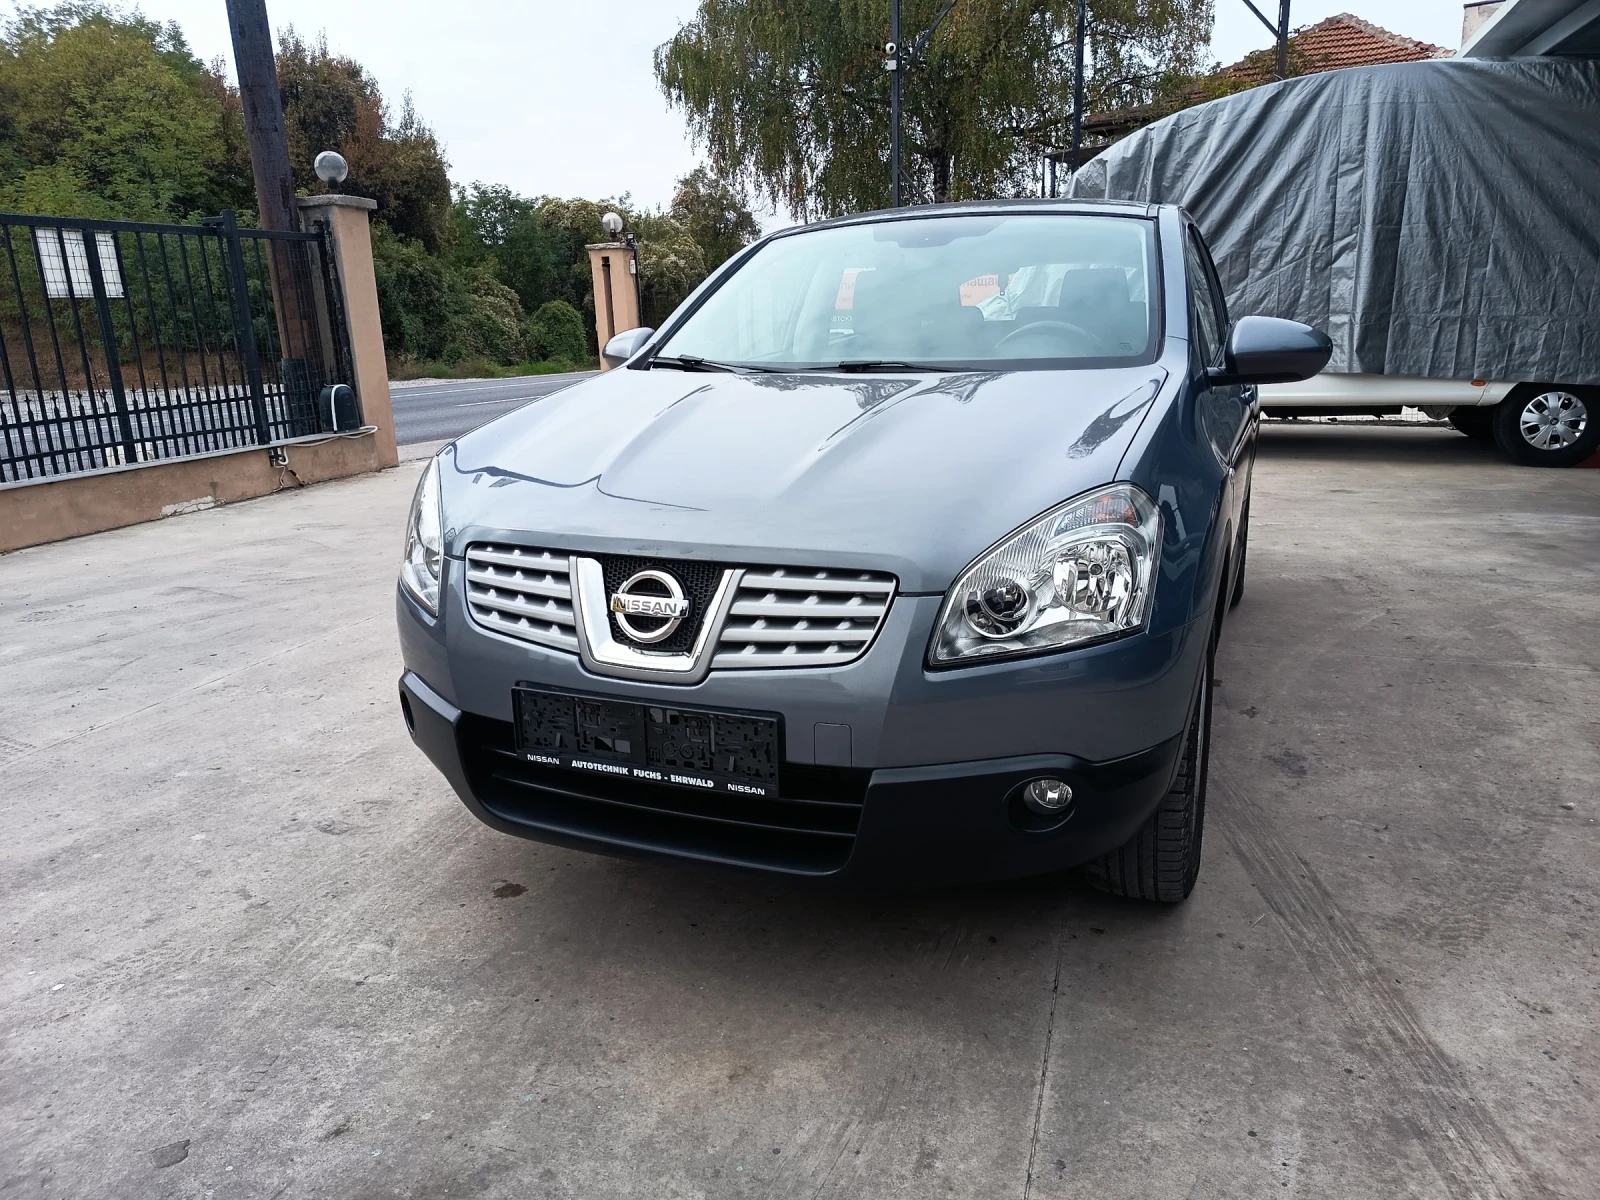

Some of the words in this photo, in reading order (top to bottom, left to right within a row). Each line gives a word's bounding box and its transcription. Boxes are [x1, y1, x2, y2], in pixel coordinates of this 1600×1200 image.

[616, 595, 677, 614] NISSAN
[527, 754, 560, 764] NISSAN
[571, 760, 629, 775] AUTOTECHNIK
[633, 769, 661, 780] FUCHS
[670, 774, 714, 788] EHRWALD
[727, 783, 765, 795] NISSAN
